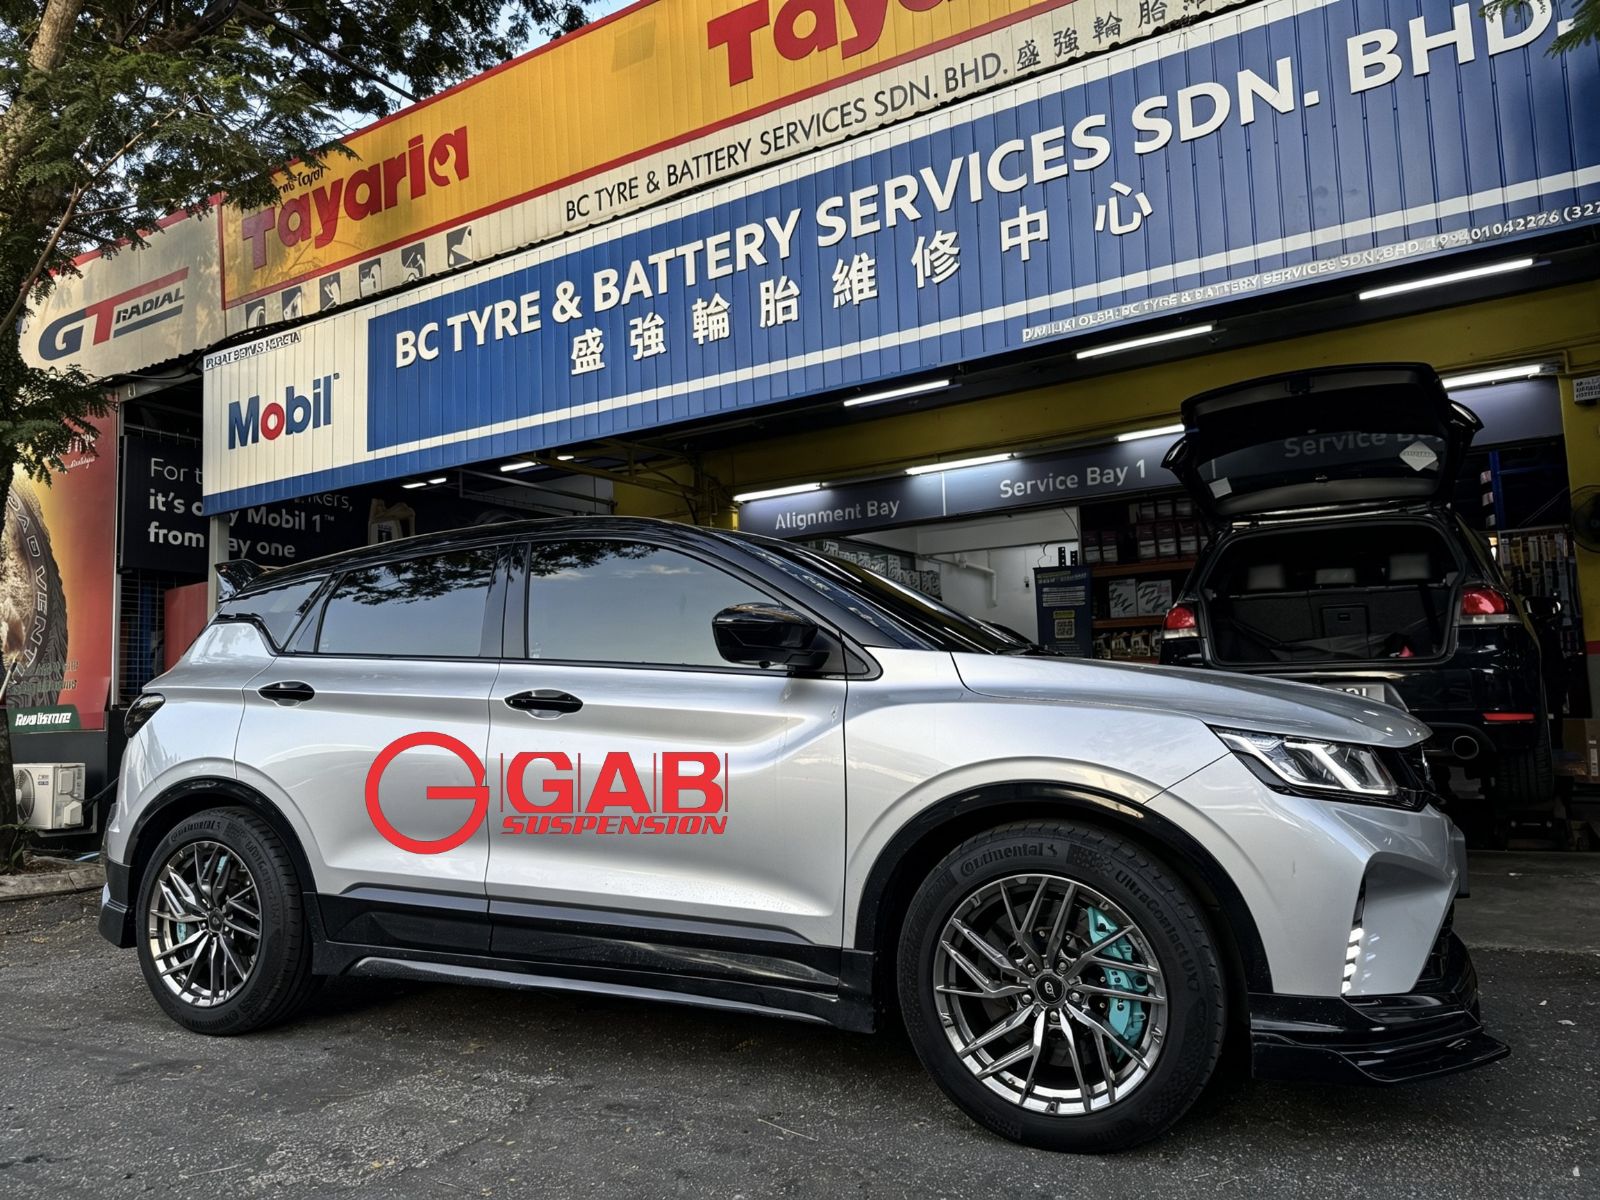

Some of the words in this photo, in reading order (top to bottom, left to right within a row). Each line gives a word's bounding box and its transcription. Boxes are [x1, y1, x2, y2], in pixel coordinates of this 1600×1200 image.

[708, 0, 947, 87] Tay
[566, 193, 590, 222] BC
[595, 170, 639, 211] TYRE
[646, 170, 660, 193] &
[667, 138, 752, 186] BATTERY
[760, 97, 867, 156] SERVICES
[874, 80, 938, 118] SDN.
[945, 56, 1007, 94] BHD.
[243, 126, 469, 269] Tayaria
[396, 325, 439, 368] BC
[447, 291, 541, 352] TYRE
[551, 281, 582, 321] &
[593, 208, 801, 312] BATTERY
[815, 114, 1111, 247] SERVICES
[1132, 57, 1320, 154] SDN.
[571, 182, 1153, 375] 盛強輪胎維修中心
[1181, 291, 1192, 303] &
[38, 266, 189, 361] GT
[115, 288, 185, 324] RADIAL
[229, 375, 331, 450] Mobil
[150, 458, 187, 483] For
[999, 470, 1079, 499] Service
[1086, 465, 1129, 487] Bay
[1135, 459, 1146, 479] 1
[148, 521, 205, 548] from
[248, 507, 306, 532] Mobil
[775, 504, 861, 531] Alignment
[867, 499, 900, 519] Bay
[228, 537, 250, 557] ay
[256, 542, 296, 558] one
